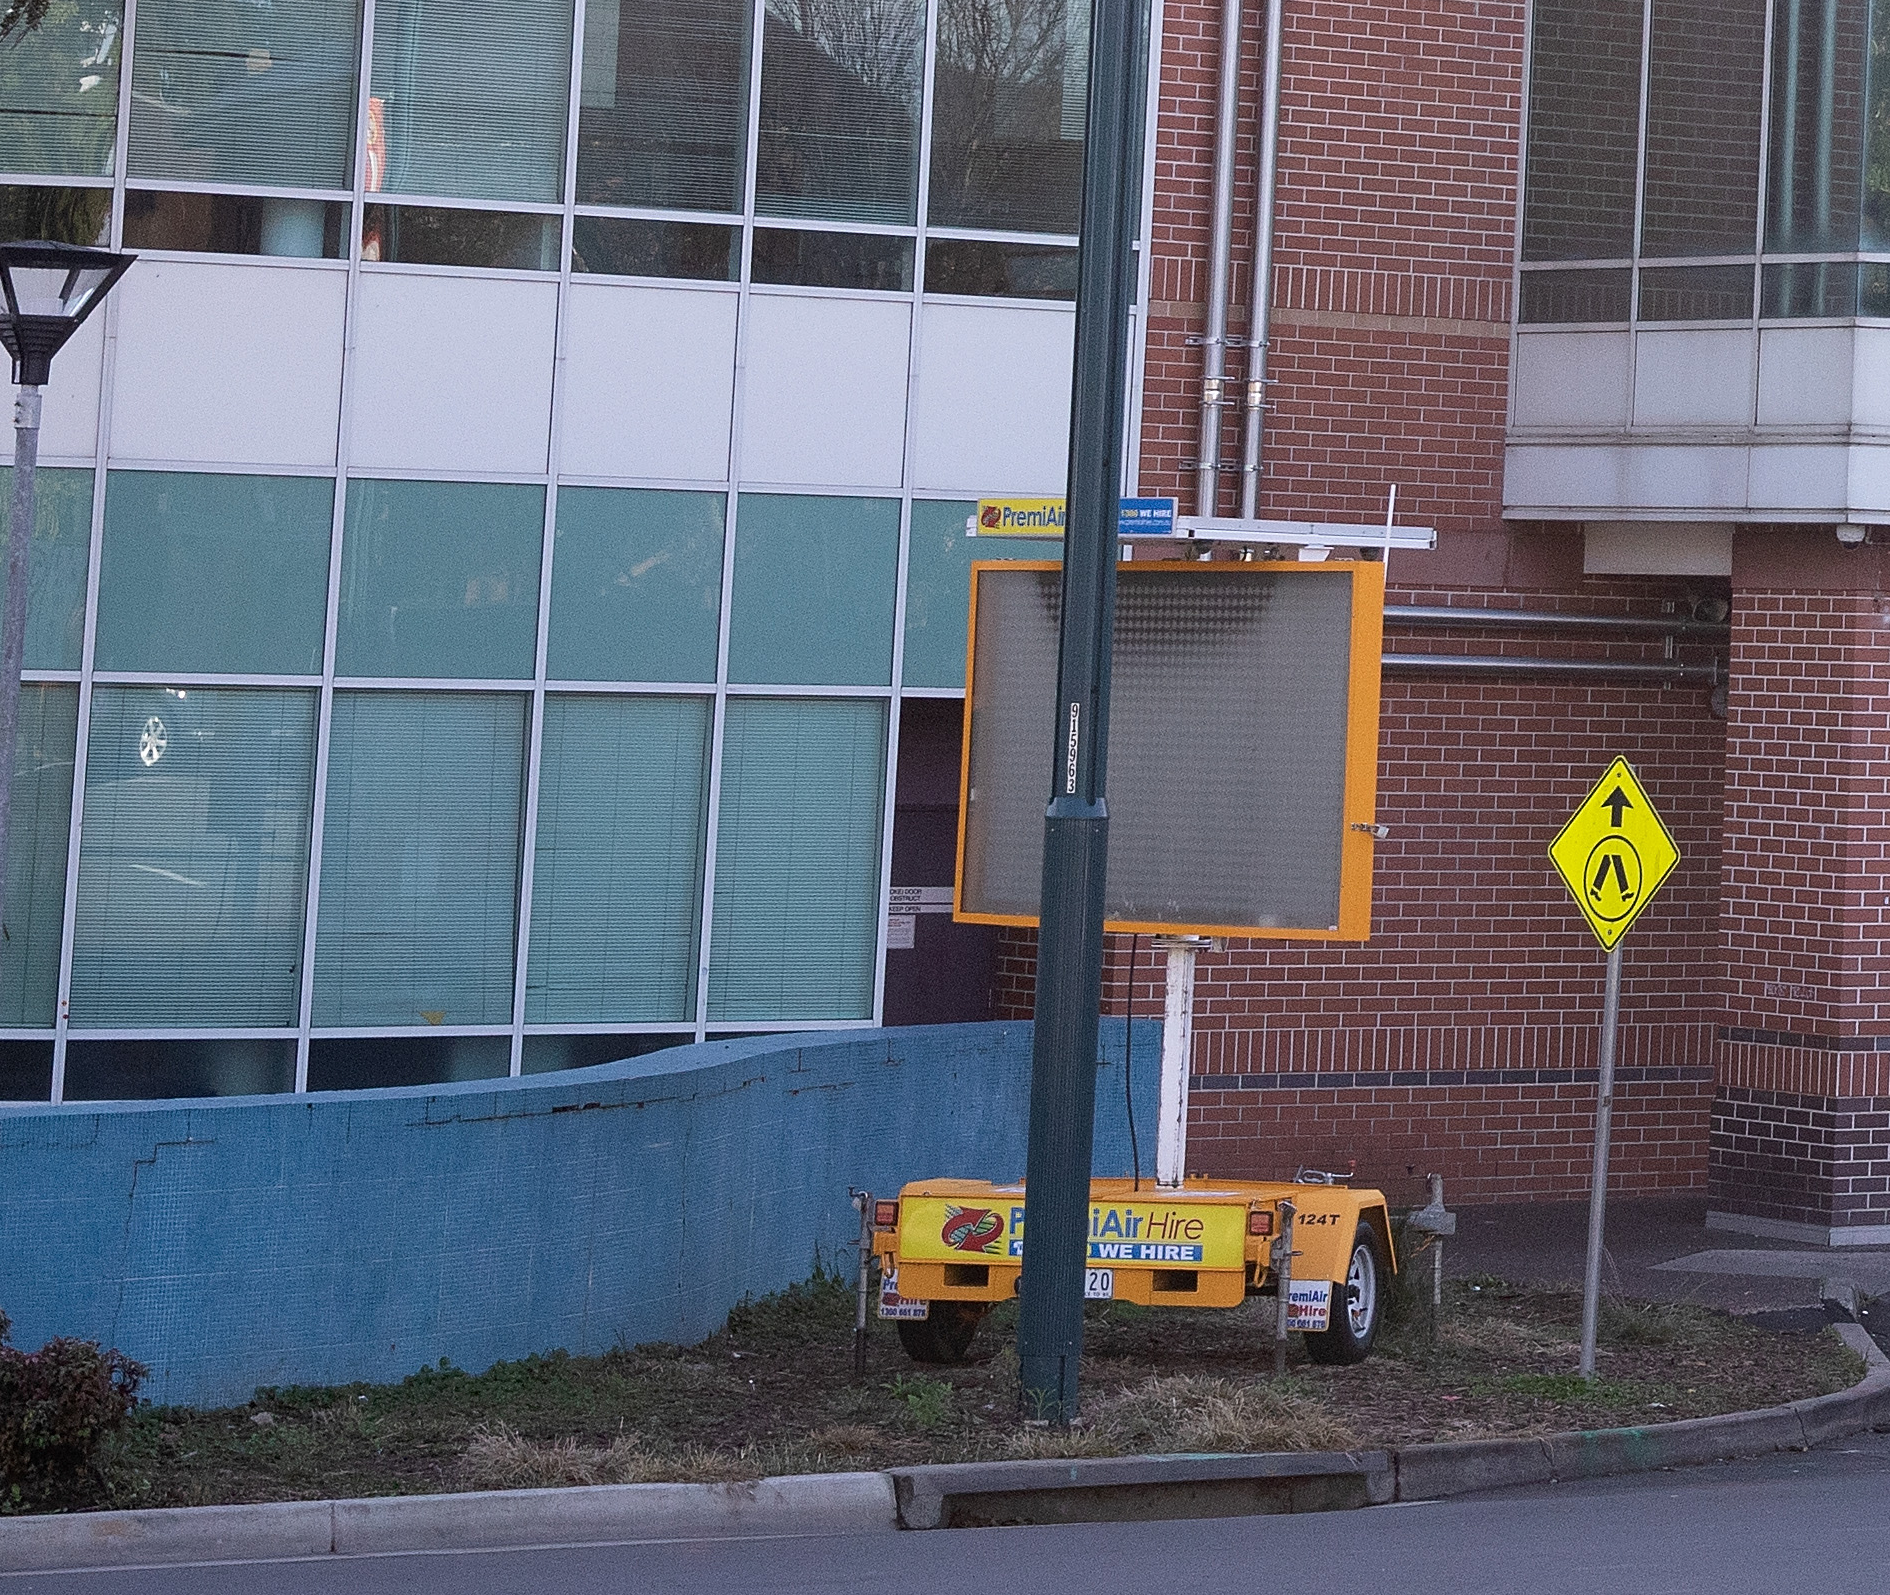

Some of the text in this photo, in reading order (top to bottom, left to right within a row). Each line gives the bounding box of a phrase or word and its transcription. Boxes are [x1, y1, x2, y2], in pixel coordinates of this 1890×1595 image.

[1068, 703, 1079, 792] 915963
[1010, 1207, 1204, 1240] PiAir Hire
[1298, 1213, 1340, 1226] 124T
[1099, 1243, 1194, 1260] WE HIRE
[1289, 1290, 1328, 1302] remiAir
[1299, 1305, 1326, 1316] Hire
